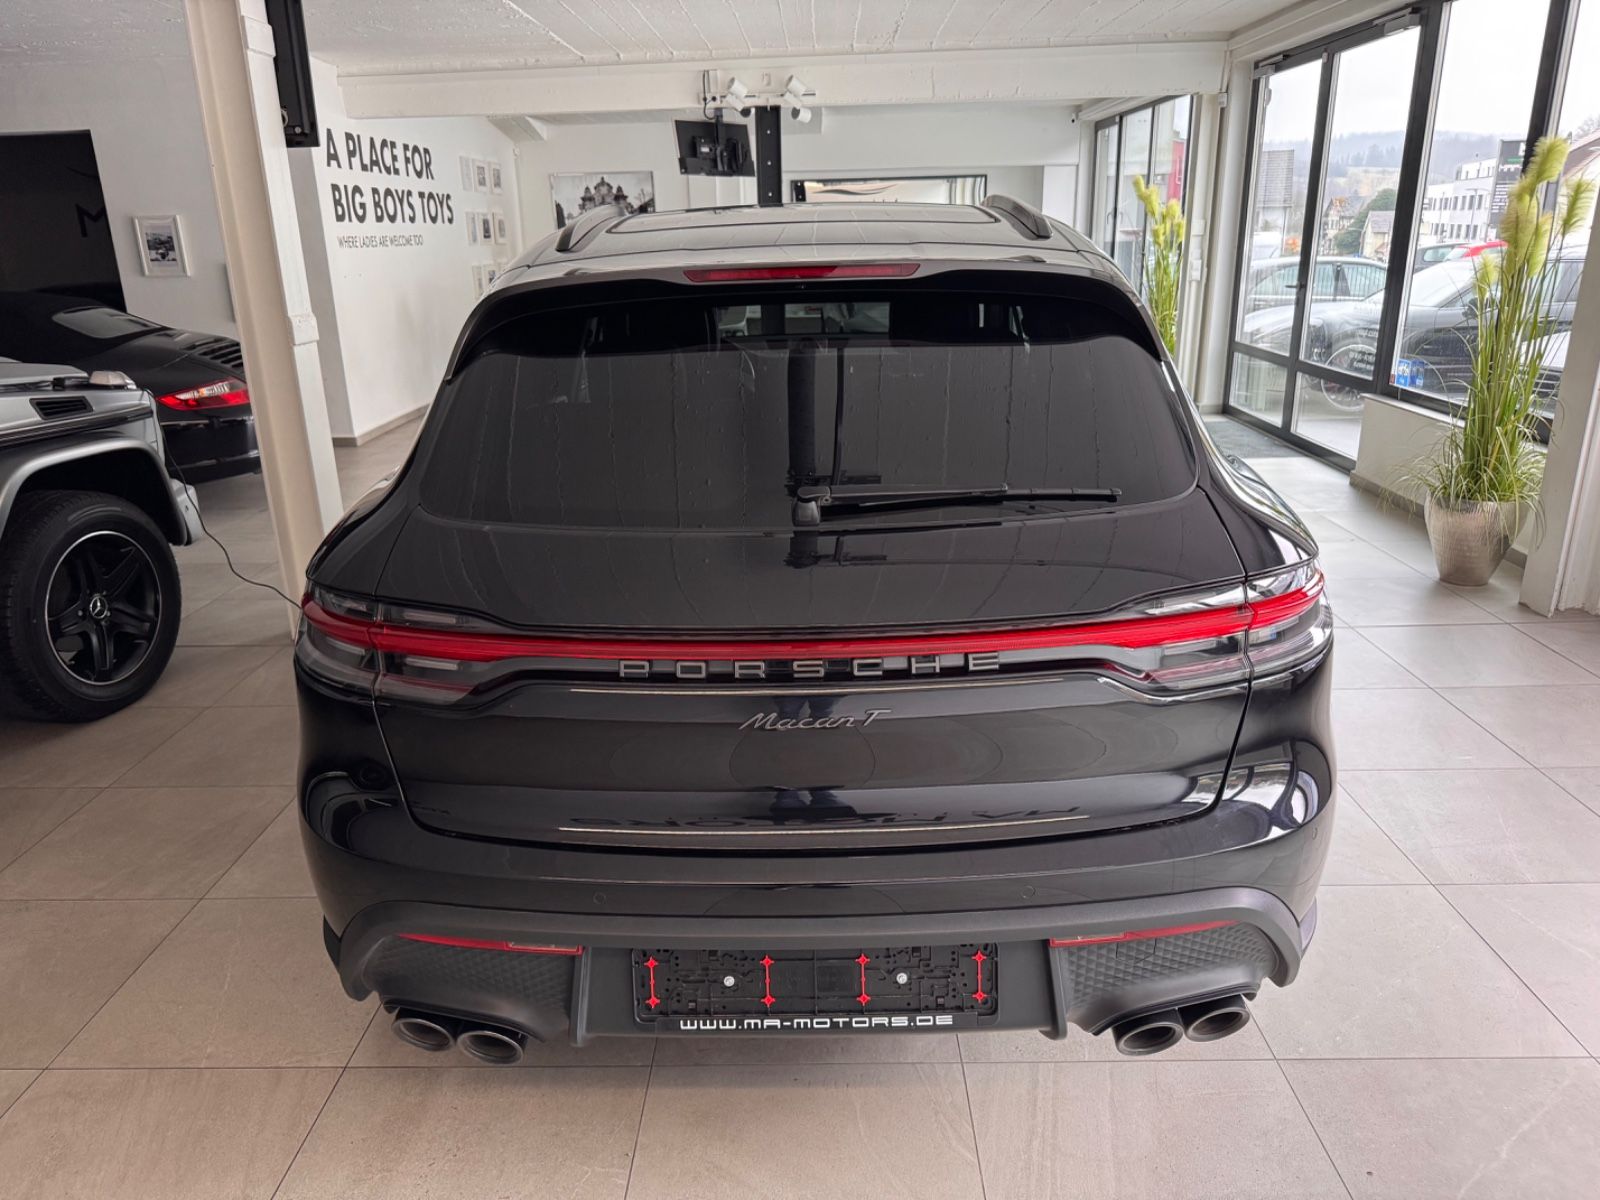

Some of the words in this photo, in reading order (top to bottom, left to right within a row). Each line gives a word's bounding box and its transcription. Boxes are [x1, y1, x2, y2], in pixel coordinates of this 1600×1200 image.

[326, 128, 342, 168] A
[344, 132, 400, 176] PLACE
[403, 143, 435, 180] FOR
[331, 183, 367, 224] BIG
[371, 186, 416, 224] BOYS
[418, 191, 454, 225] TOYS
[337, 235, 358, 249] WHERE
[359, 235, 378, 249] LADIES
[379, 235, 389, 248] ARE
[619, 652, 1000, 679] PORSCHE
[738, 712, 856, 730] Macan
[863, 708, 892, 726] T
